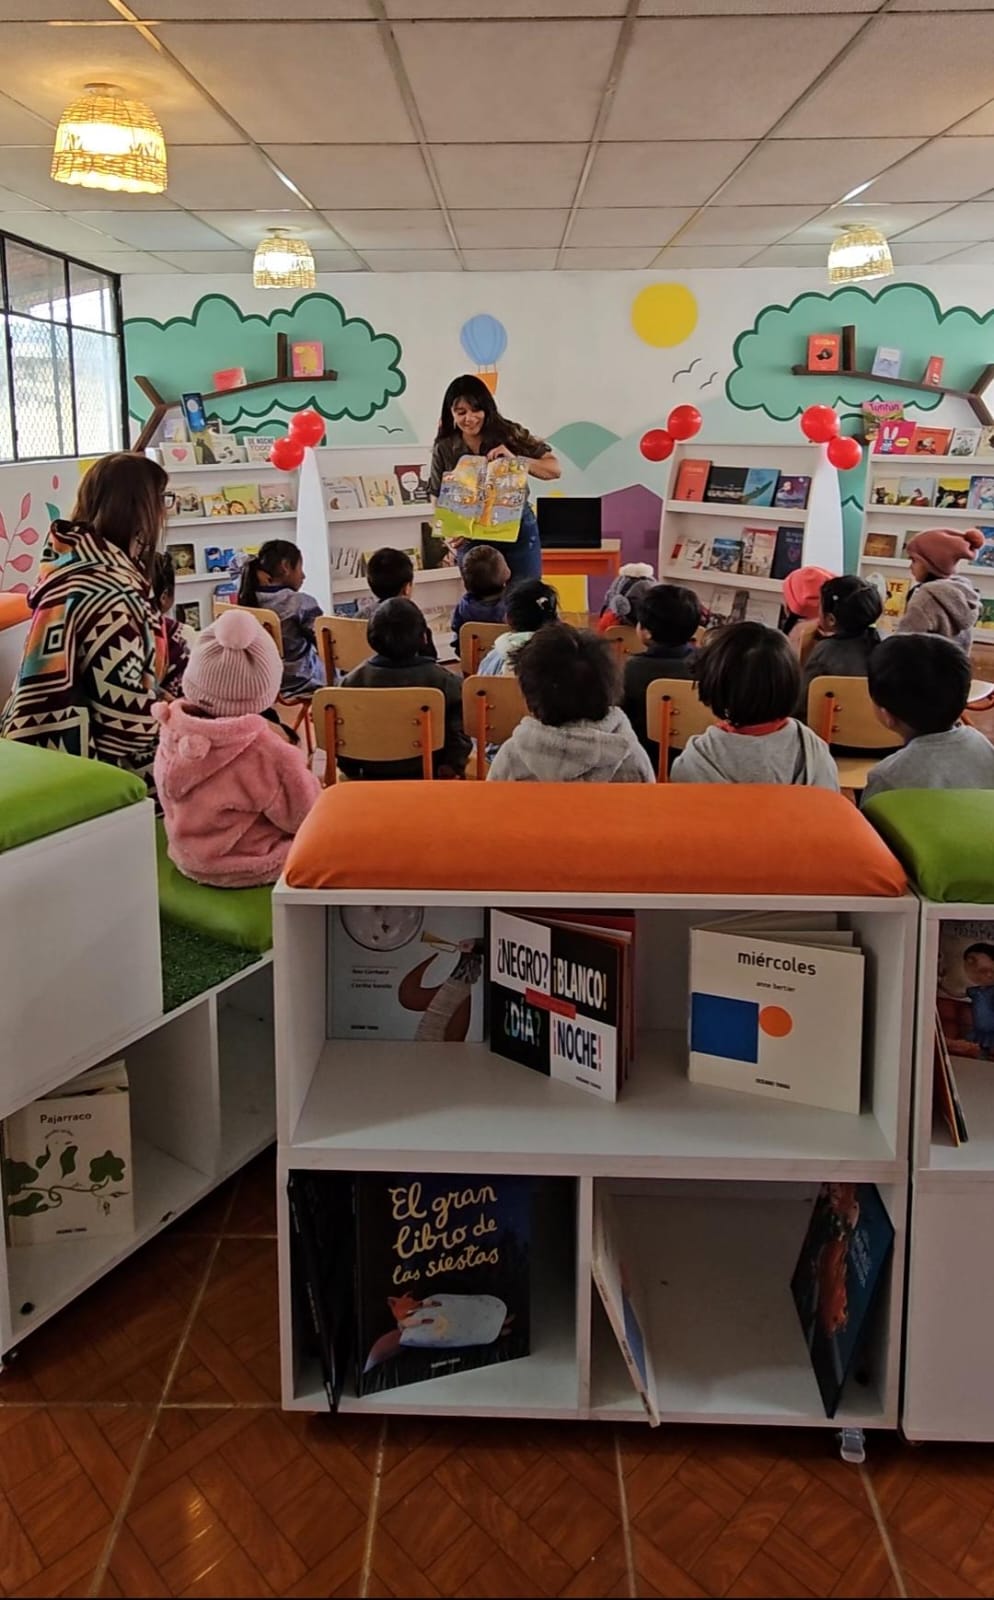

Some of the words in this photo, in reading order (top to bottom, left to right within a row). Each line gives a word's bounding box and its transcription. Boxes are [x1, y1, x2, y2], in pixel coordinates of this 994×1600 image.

[497, 938, 549, 989] ¿NEGRO?
[553, 957, 608, 1011] ¡BLANCO!
[737, 951, 817, 976] miércoles
[504, 996, 541, 1047] ¿DÍA?
[552, 1019, 603, 1073] ¡NOCHE!
[40, 1113, 92, 1125] Pajarraco
[388, 1181, 427, 1220] El
[431, 1184, 498, 1229] gran
[392, 1225, 469, 1259] libro
[472, 1212, 498, 1237] de
[392, 1265, 421, 1285] las
[425, 1245, 499, 1278] siestas
